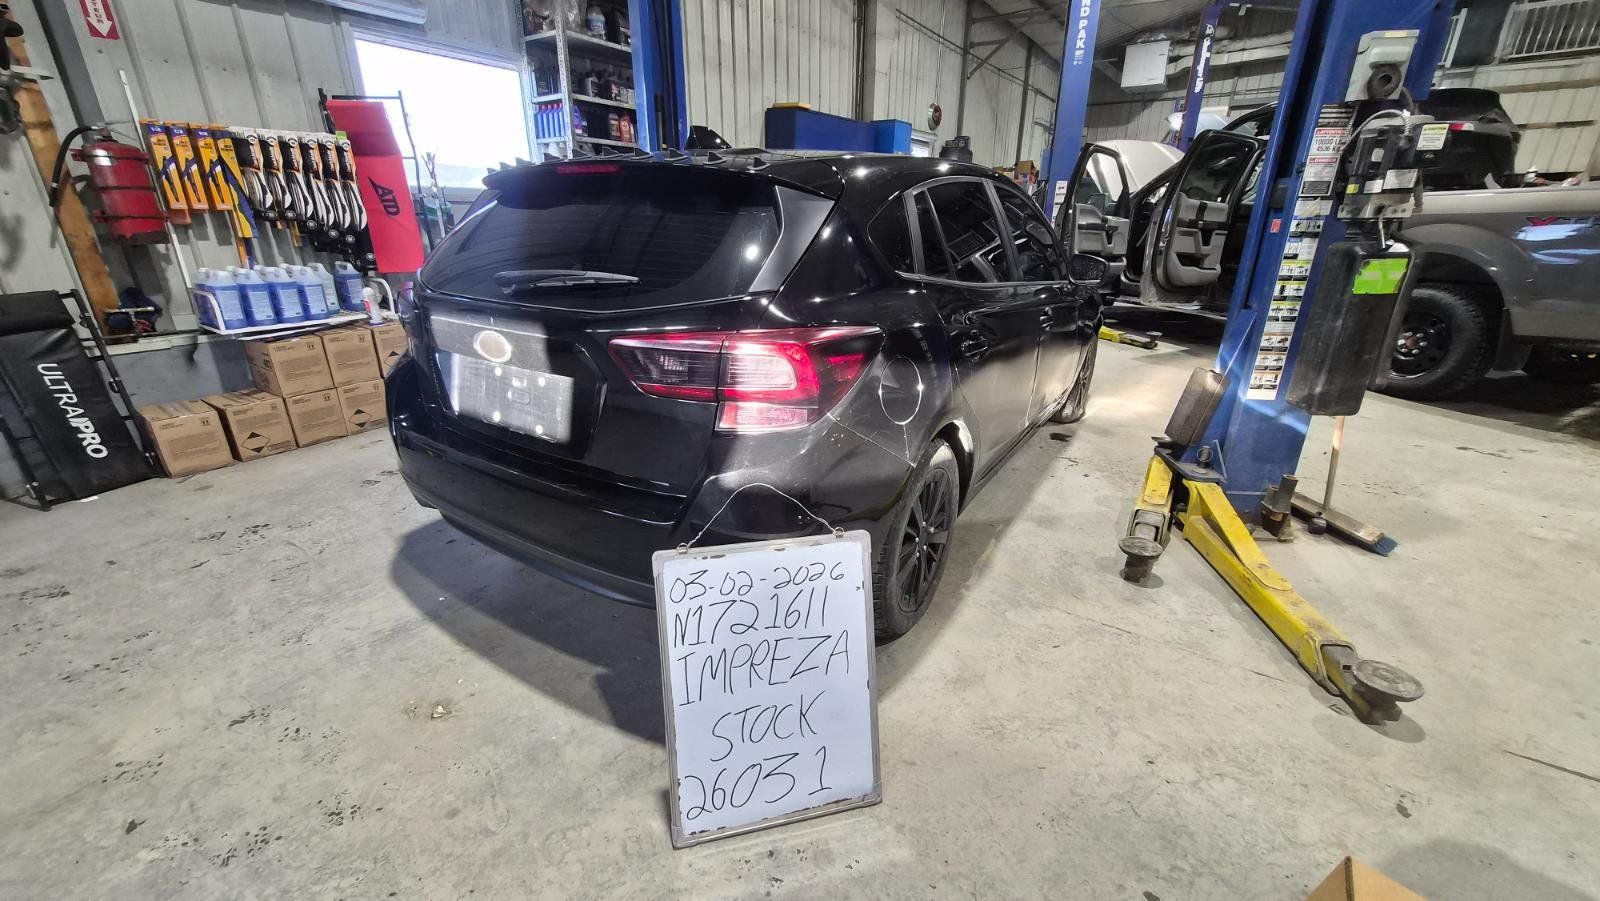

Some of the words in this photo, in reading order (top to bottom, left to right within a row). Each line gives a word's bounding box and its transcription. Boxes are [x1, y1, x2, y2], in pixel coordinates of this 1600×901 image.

[368, 176, 400, 216] ATD
[669, 561, 845, 604] 03-02-2026
[676, 629, 850, 706] IMPREZA
[709, 690, 826, 762] STOCK
[684, 745, 833, 821] 26031
